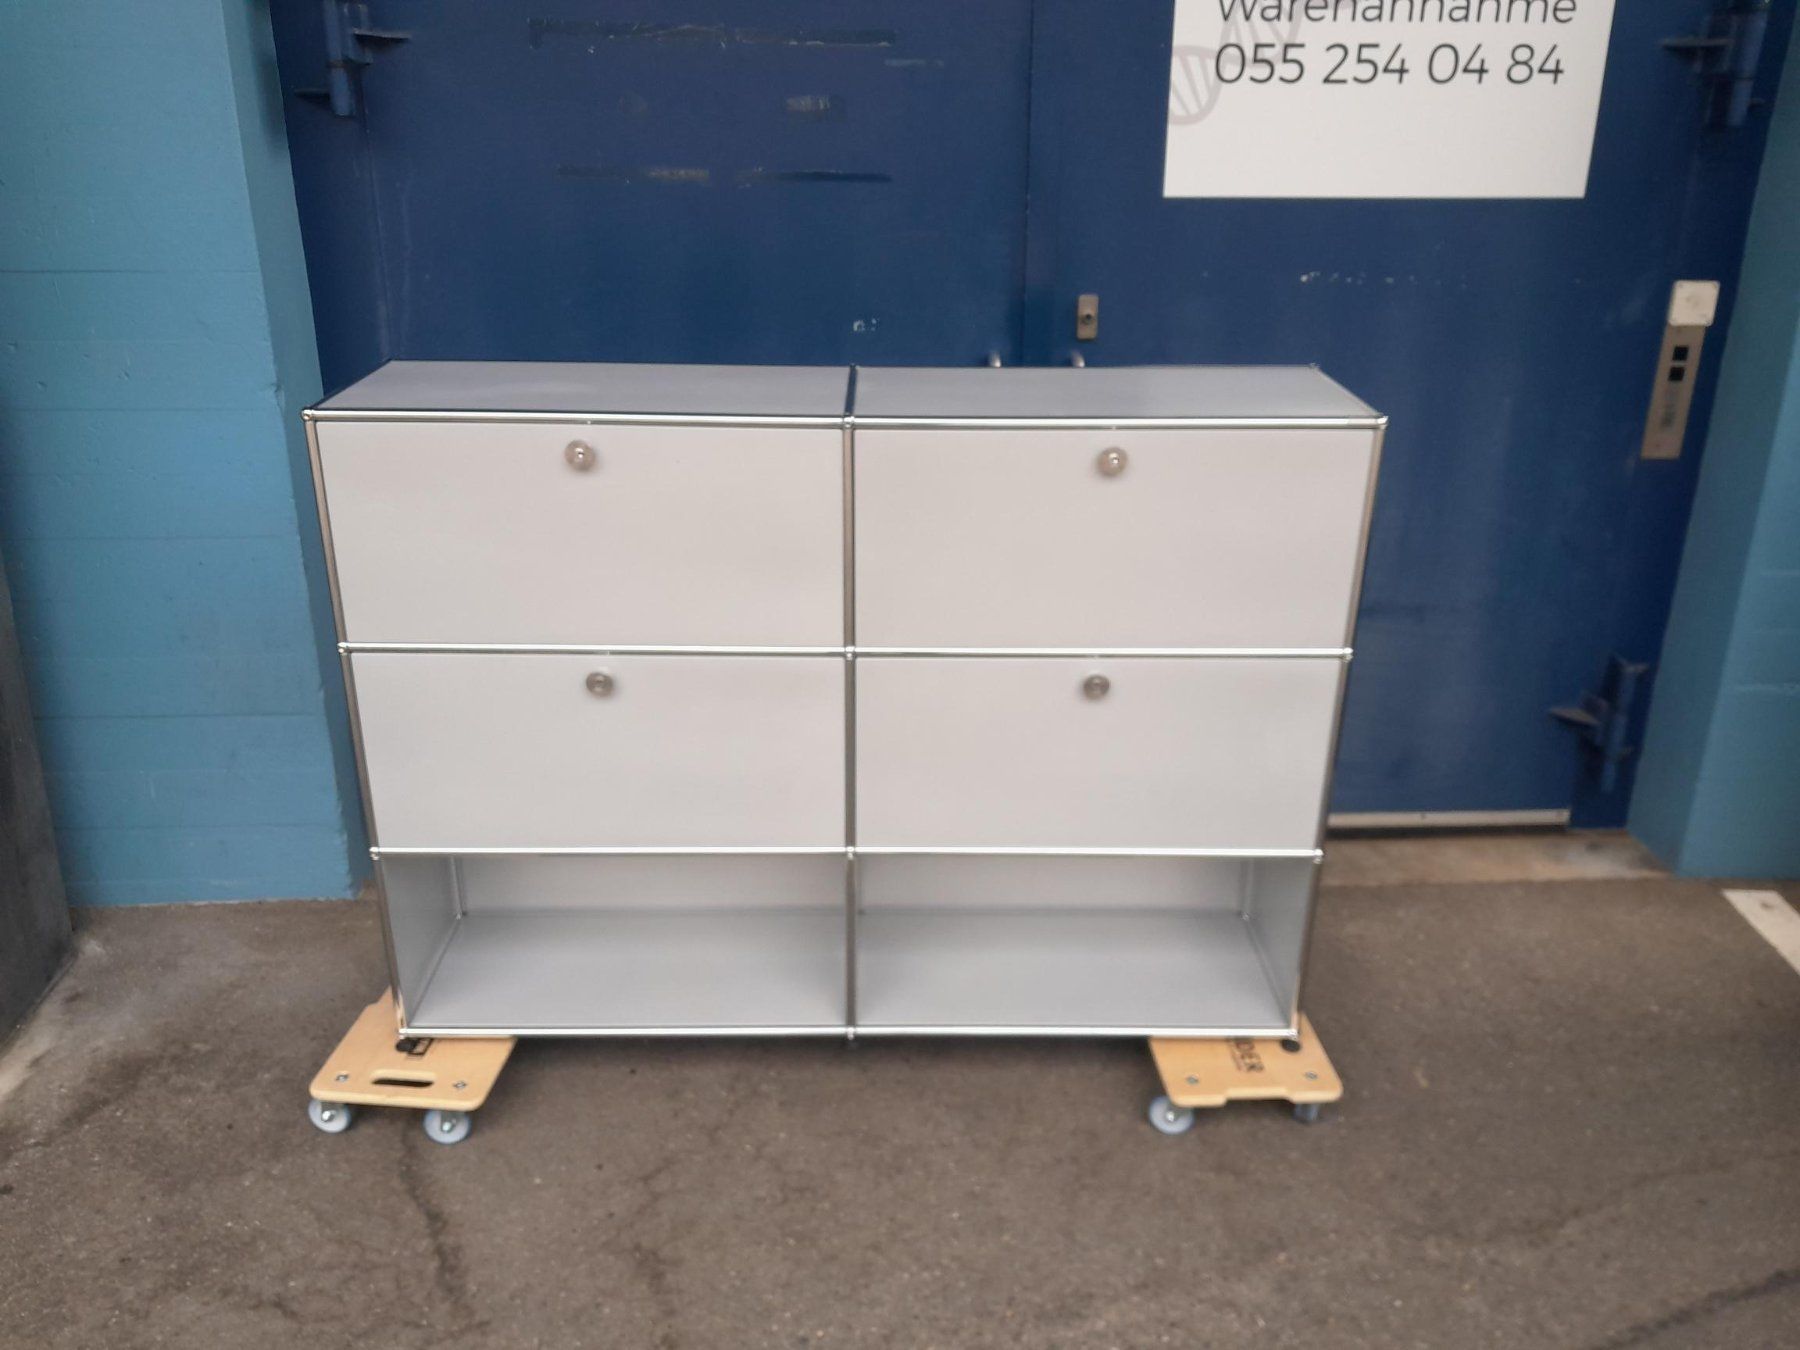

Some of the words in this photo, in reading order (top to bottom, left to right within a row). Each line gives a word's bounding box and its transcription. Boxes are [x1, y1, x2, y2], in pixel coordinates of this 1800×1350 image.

[1215, 43, 1305, 84] 055
[1322, 43, 1409, 84] 254
[1428, 43, 1489, 84] 04
[1506, 43, 1564, 85] 84
